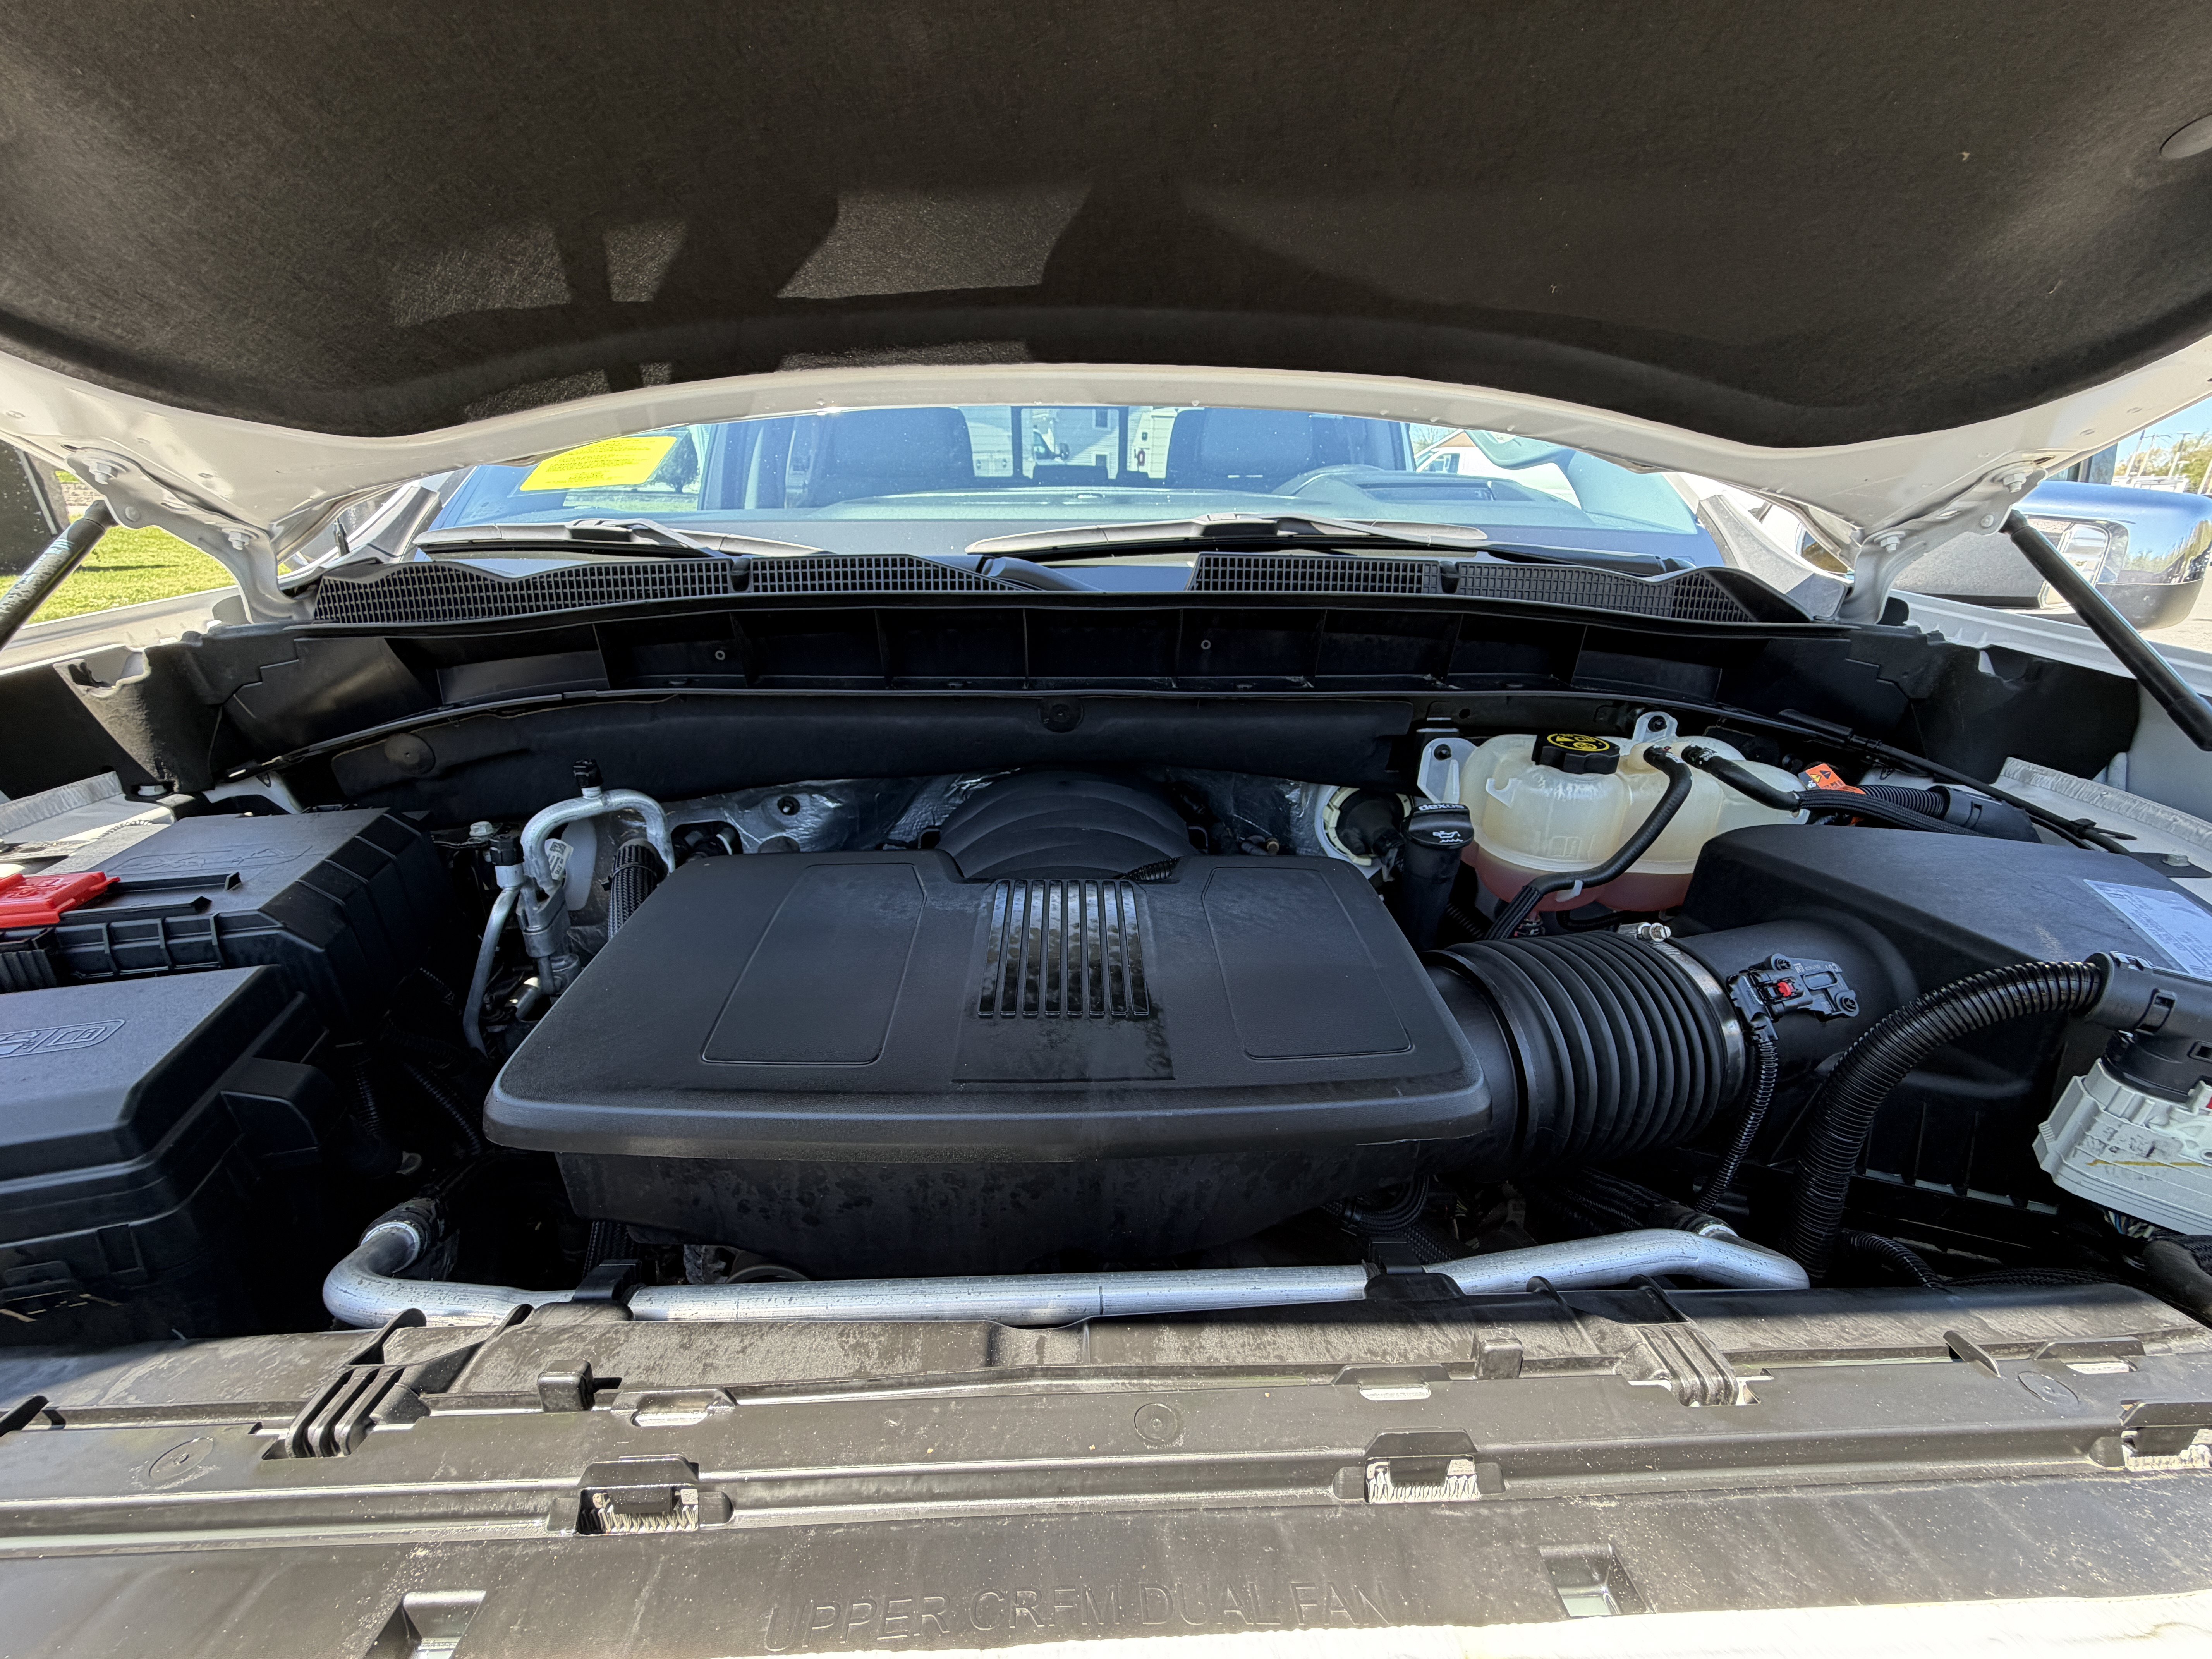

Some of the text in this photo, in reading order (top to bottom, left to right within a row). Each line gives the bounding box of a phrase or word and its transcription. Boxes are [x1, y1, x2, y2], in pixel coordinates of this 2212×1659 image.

[764, 1580, 1391, 1652] UPPER CRFM DUAL FAN
